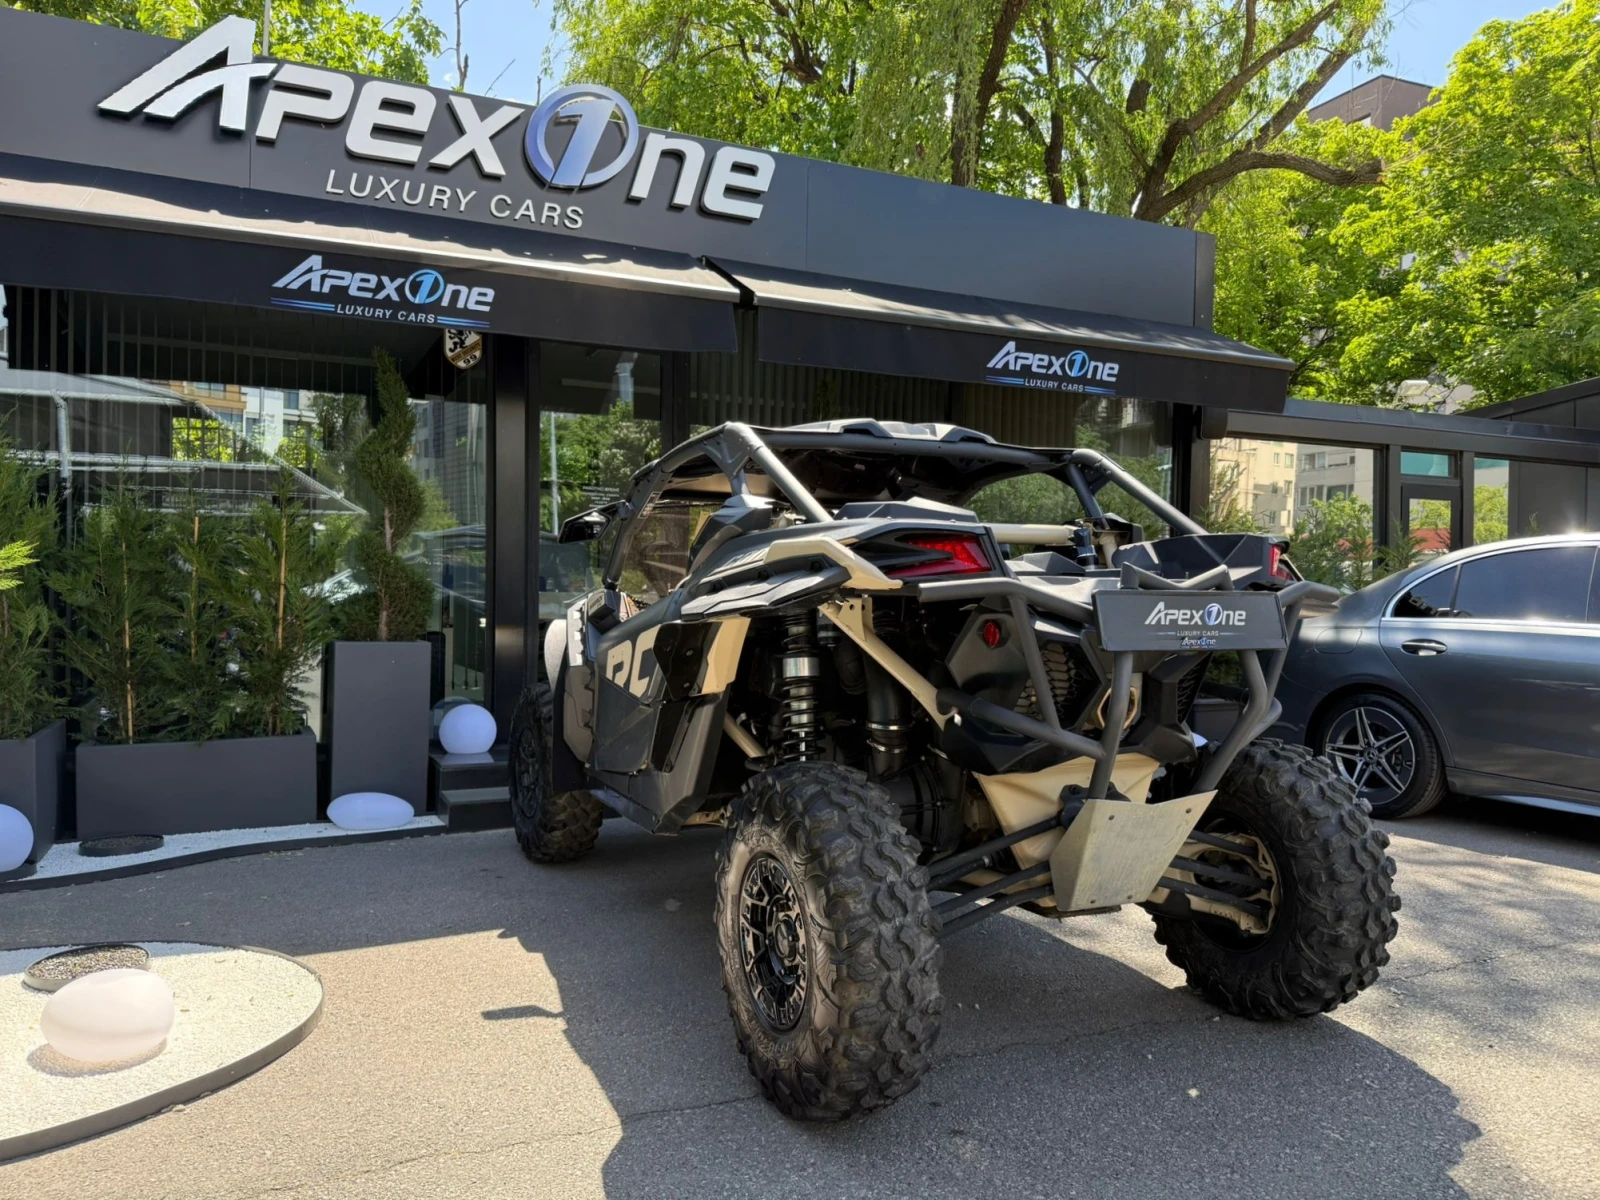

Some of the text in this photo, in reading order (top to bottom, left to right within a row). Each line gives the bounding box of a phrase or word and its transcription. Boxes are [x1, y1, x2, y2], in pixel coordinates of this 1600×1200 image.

[325, 169, 584, 229] LUXURY CARS
[337, 304, 435, 324] LUXURY CARS
[463, 354, 477, 365] 99
[1025, 378, 1084, 393] LUXURY CARS
